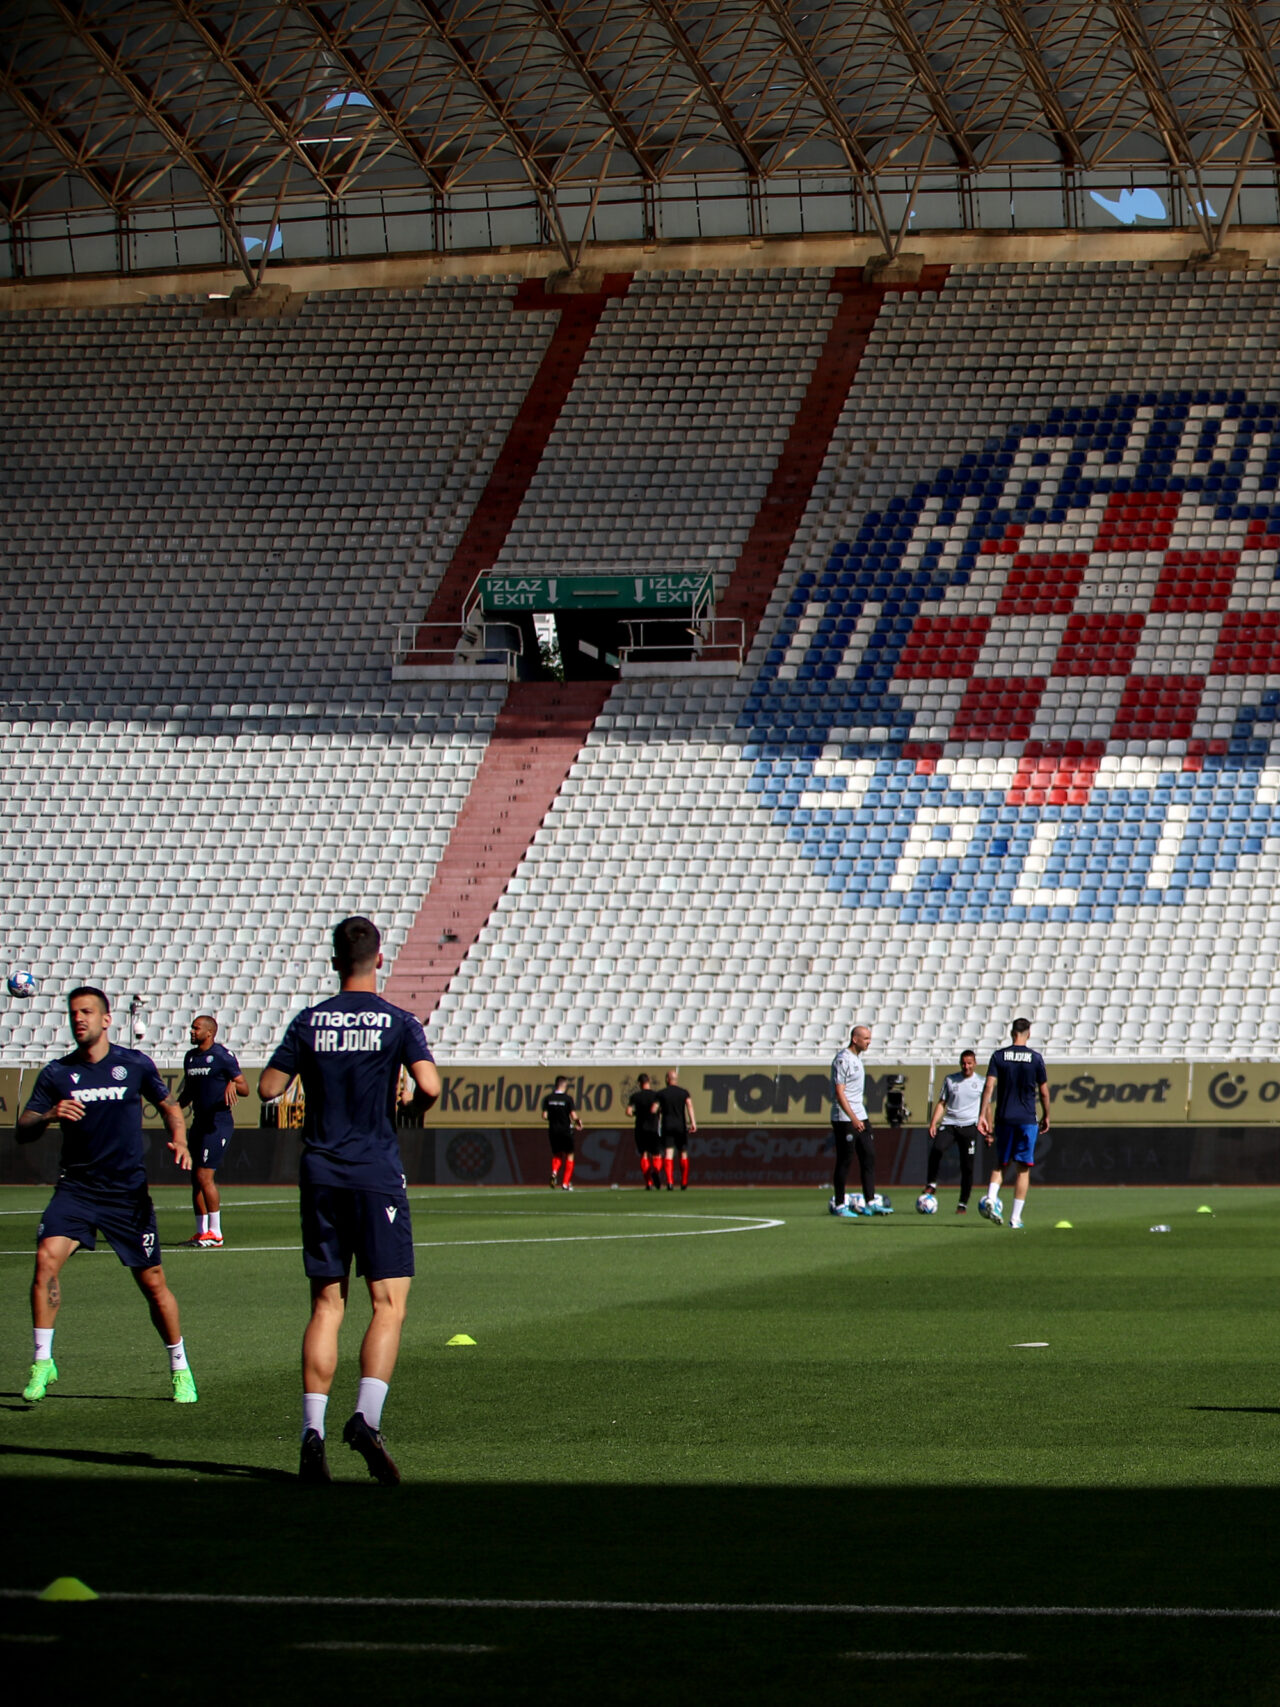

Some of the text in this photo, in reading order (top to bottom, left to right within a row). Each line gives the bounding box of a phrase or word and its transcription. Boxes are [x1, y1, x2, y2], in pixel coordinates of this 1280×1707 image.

[486, 579, 543, 592] IZLAZ
[649, 577, 706, 590] IZLAZ
[493, 593, 537, 605] EXIT
[656, 590, 698, 604] EXIT
[309, 1011, 392, 1028] macron
[314, 1029, 382, 1052] HAJDUK
[70, 1086, 128, 1103] TOMMY
[440, 1075, 613, 1113] Karlovko
[142, 1232, 155, 1247] 27
